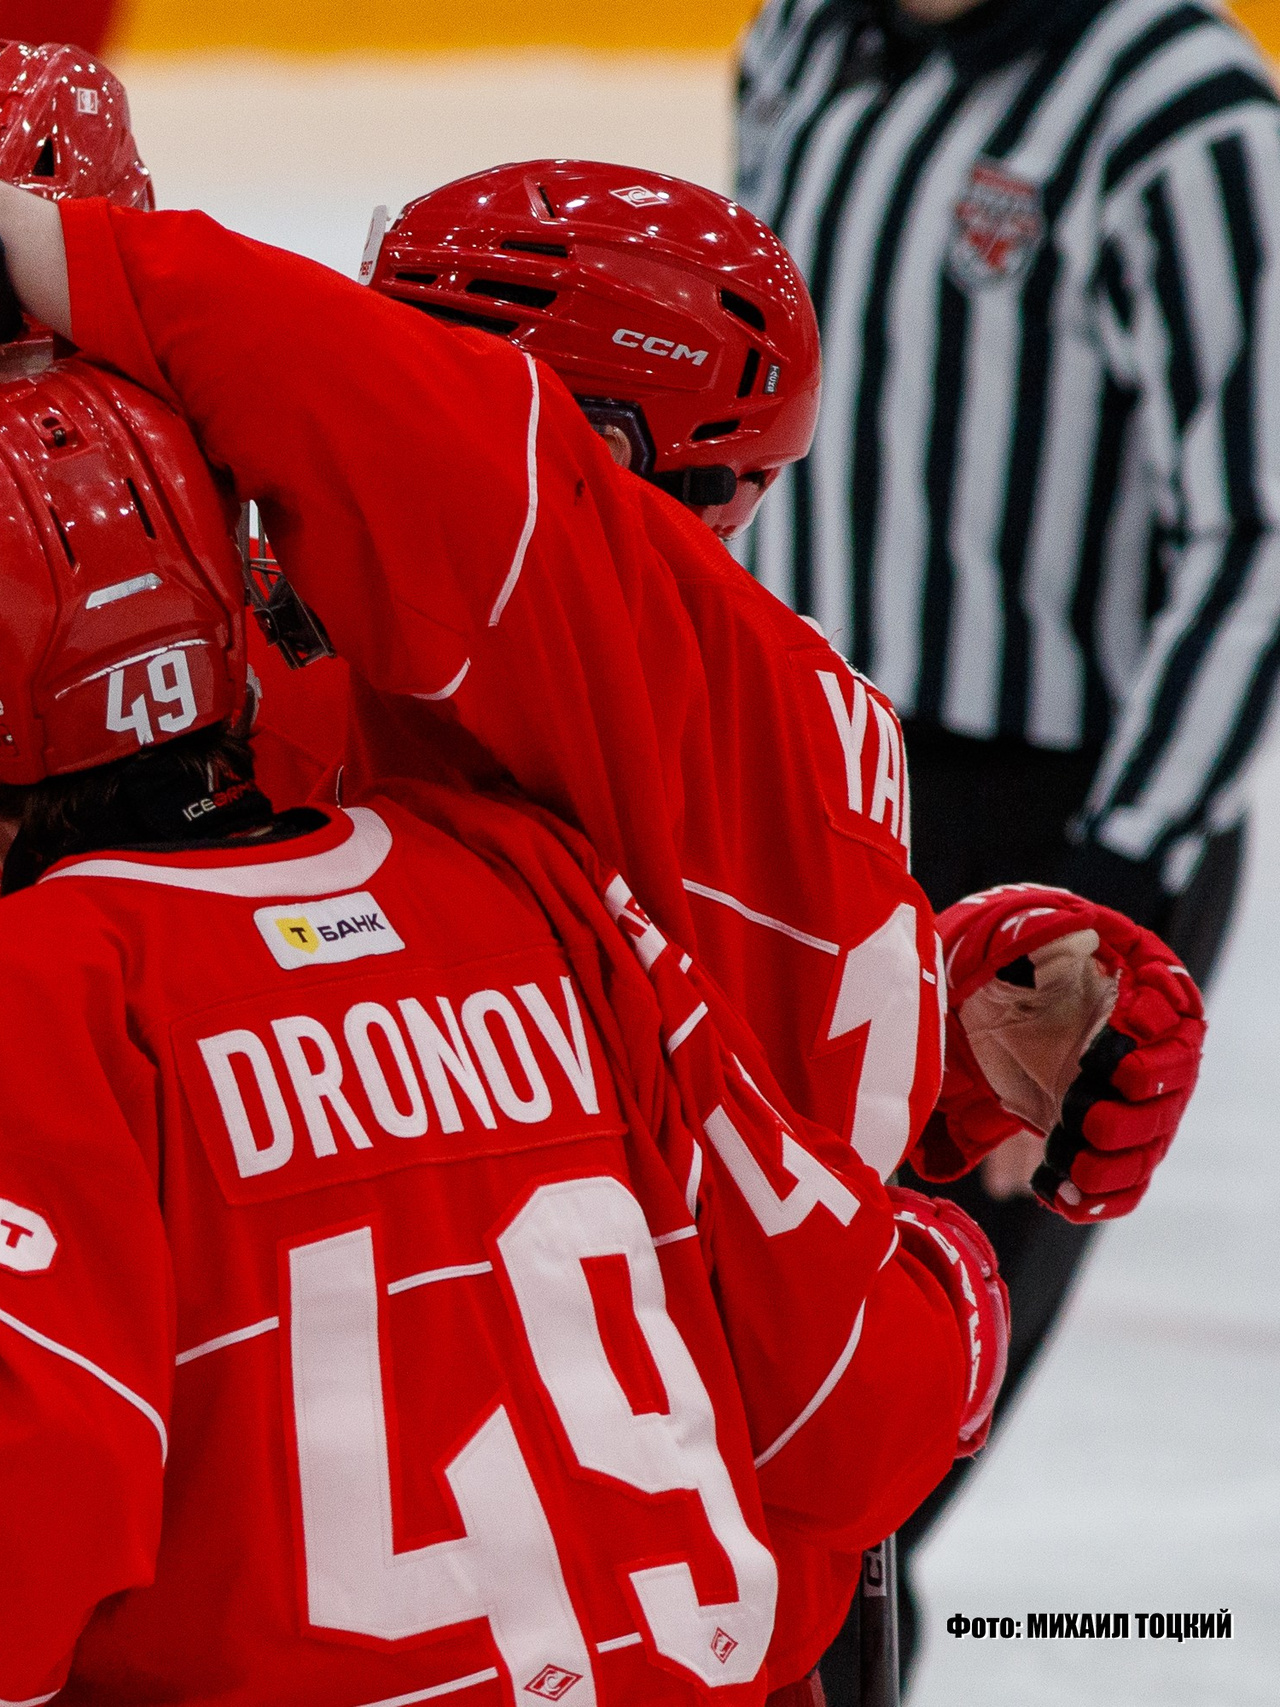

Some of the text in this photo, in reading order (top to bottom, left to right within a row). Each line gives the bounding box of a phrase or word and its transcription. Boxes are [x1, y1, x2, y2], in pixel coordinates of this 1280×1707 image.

[612, 328, 709, 366] CCM
[106, 650, 198, 746] 49
[815, 669, 910, 850] YA
[317, 913, 386, 942] БАНК
[197, 976, 601, 1179] DRONOV
[289, 1175, 779, 1707] 49
